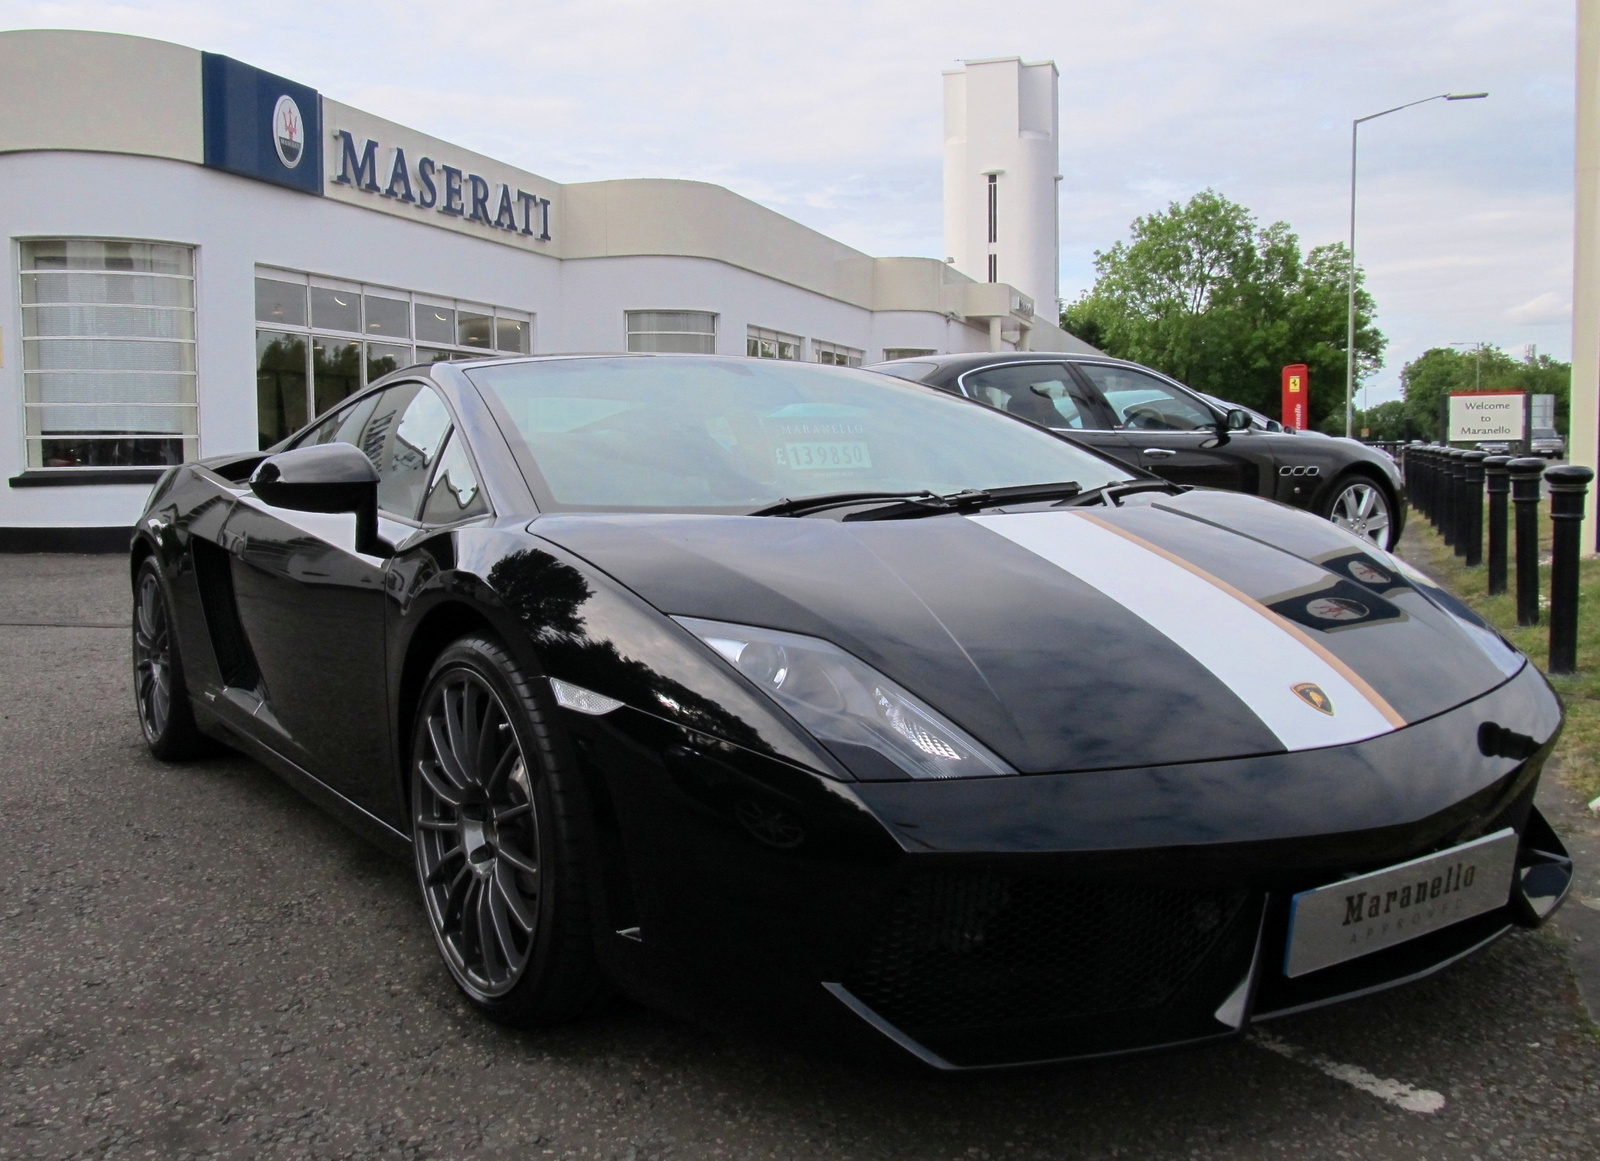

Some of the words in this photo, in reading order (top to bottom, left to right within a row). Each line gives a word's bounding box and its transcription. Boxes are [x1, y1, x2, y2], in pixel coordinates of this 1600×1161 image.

[332, 128, 552, 242] MASERATI
[1465, 401, 1510, 410] Welcome
[781, 424, 863, 435] MARANELLO
[1460, 425, 1511, 435] Maranello
[1341, 862, 1476, 926] Maranello
